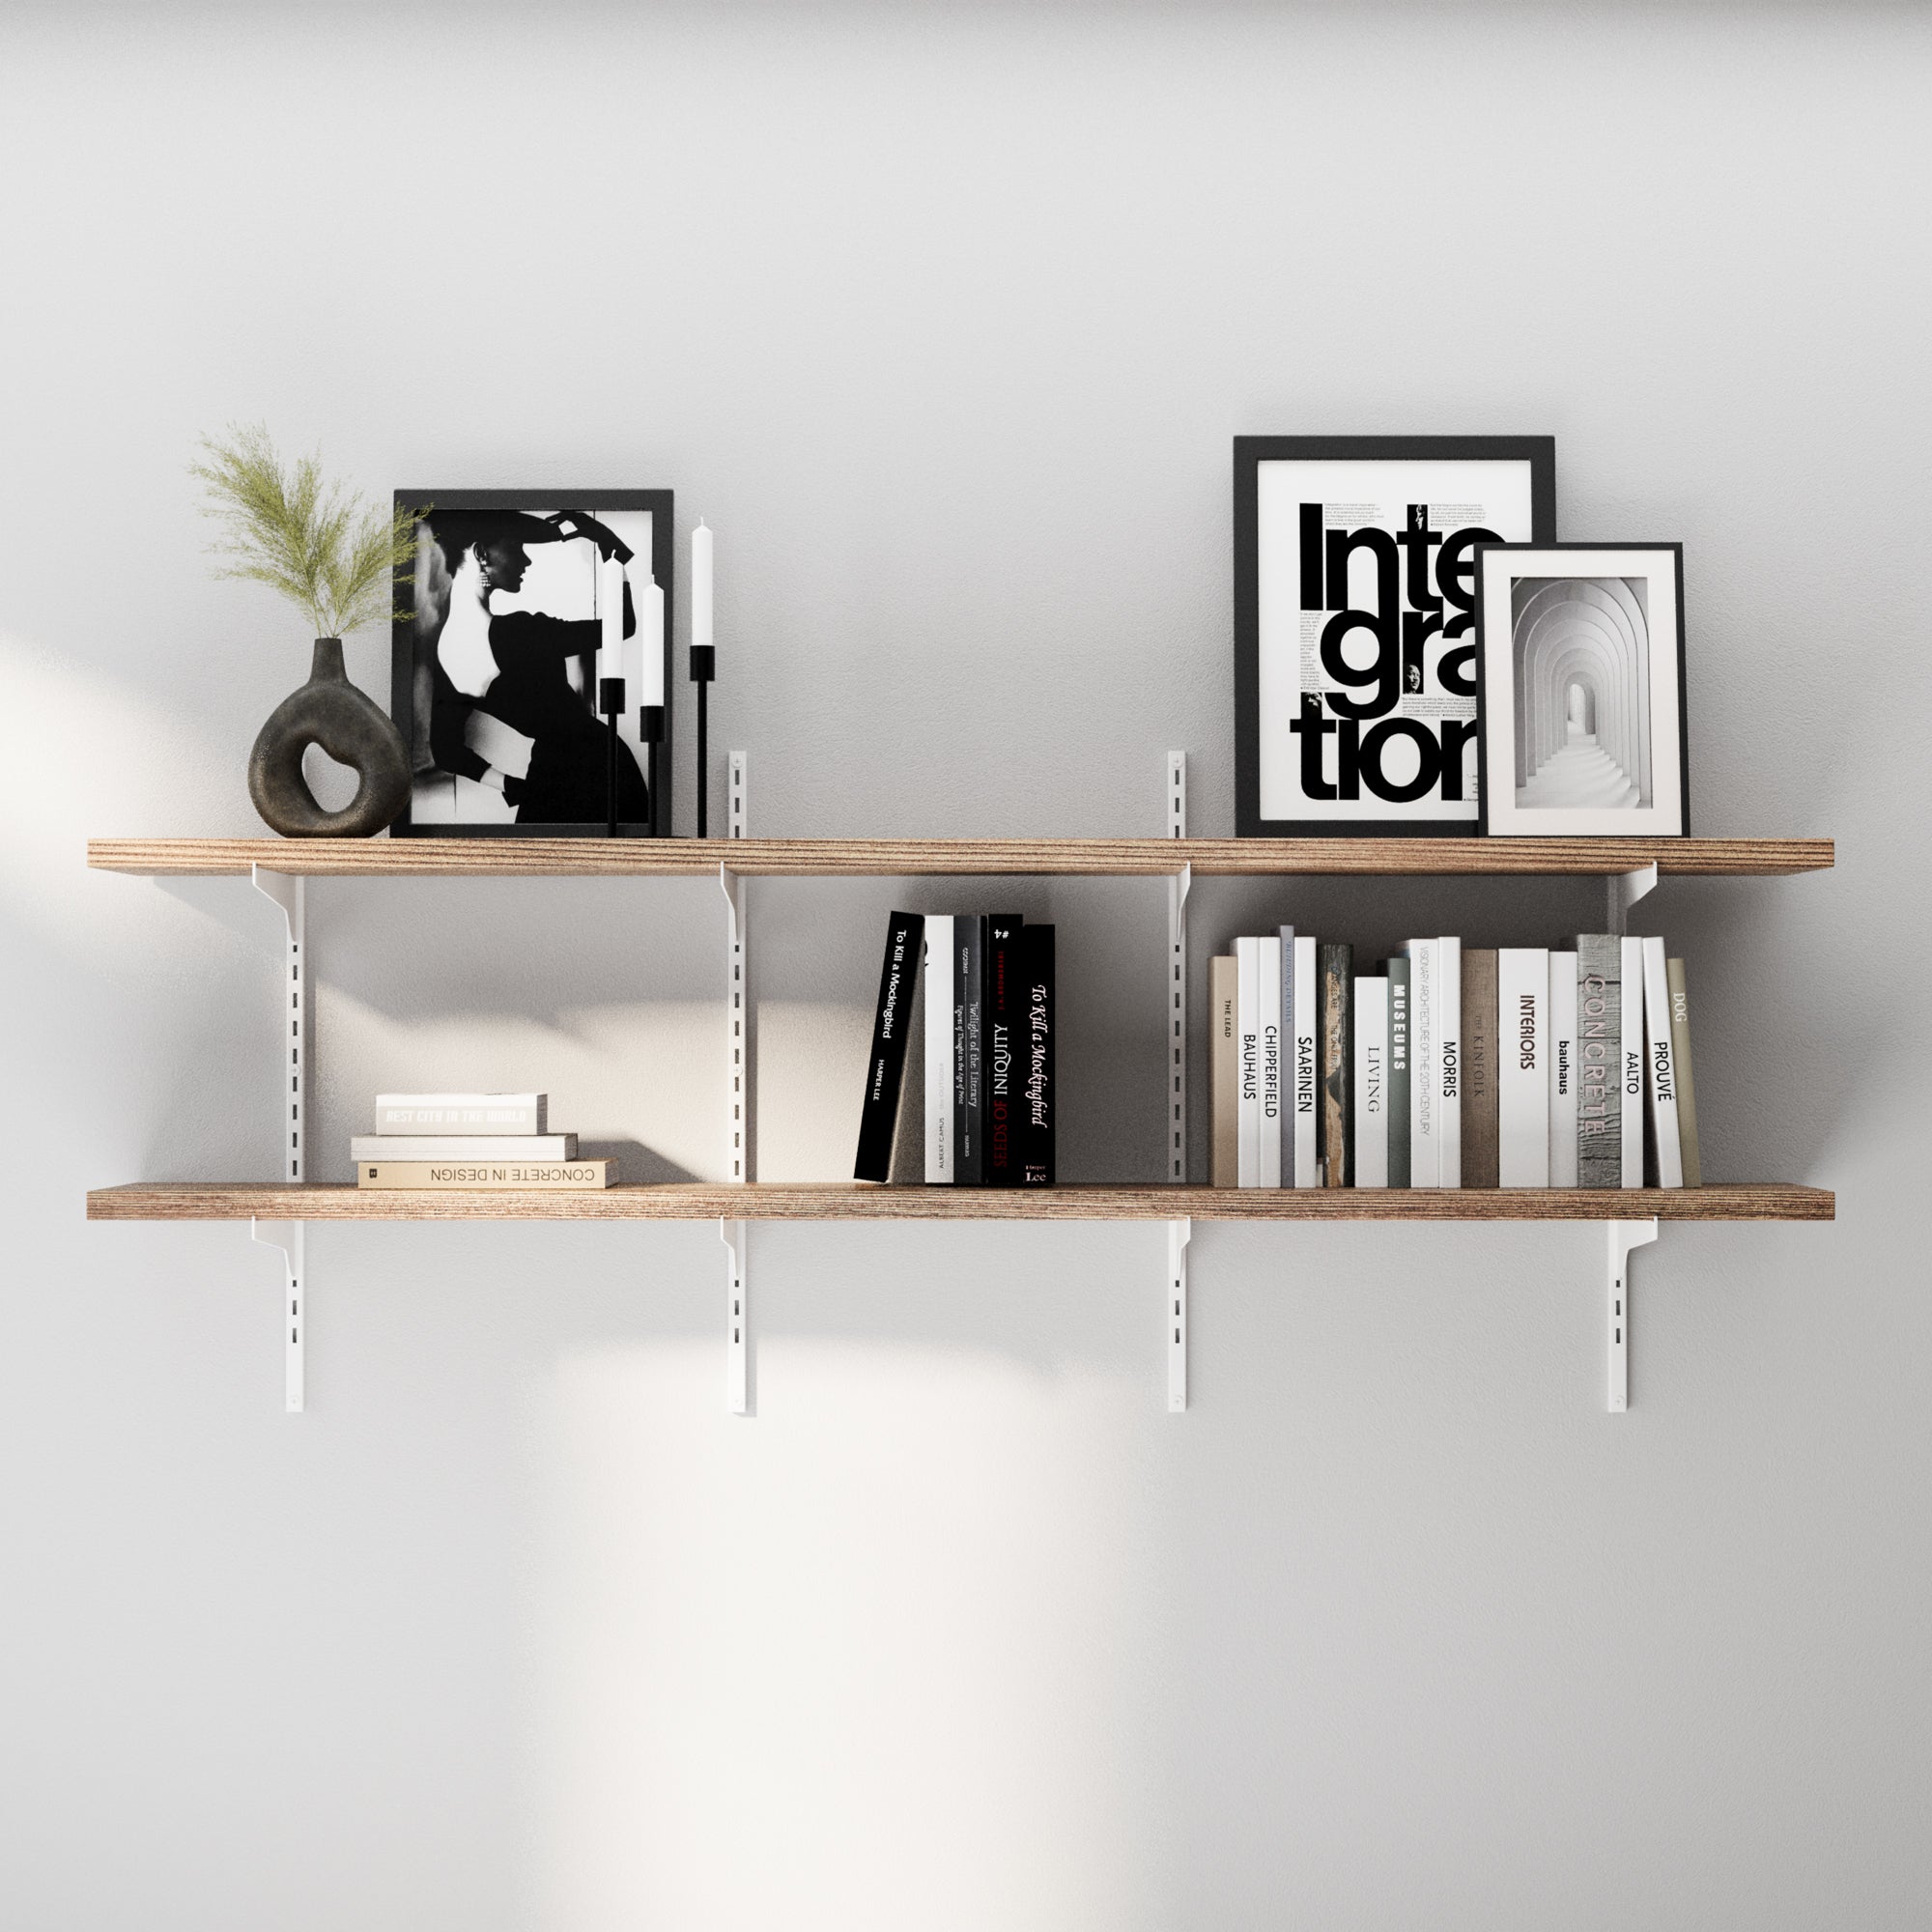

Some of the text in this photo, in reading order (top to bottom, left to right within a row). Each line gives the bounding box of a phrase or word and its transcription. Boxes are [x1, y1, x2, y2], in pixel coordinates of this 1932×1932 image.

[894, 945, 905, 962] Kill
[895, 930, 907, 943] To
[994, 928, 1009, 939] #4
[882, 972, 901, 1039] Mockingbird
[1032, 984, 1047, 1002] To
[1032, 1005, 1048, 1033] Kill
[1673, 992, 1688, 1023] DOG
[968, 1001, 980, 1107] Twilight of the Literary
[1394, 984, 1406, 1070] MUSEUMS
[1420, 947, 1430, 1136] VISIONARY ARCHITECTURE OF THE 20TH CENTURY
[1520, 994, 1536, 1070] INTERIORS
[1584, 975, 1605, 1134] CONCRETE
[872, 1059, 885, 1101] HARPER LEE
[993, 1023, 1011, 1168] SEEDS OF INIQUITY
[1025, 1044, 1048, 1128] Mockingbird
[1243, 1034, 1257, 1100] BAUHAUS
[1264, 1025, 1277, 1118] CHIPPERFIELD
[1297, 1037, 1313, 1113] SAARINEN
[1368, 1047, 1380, 1113] LIVING
[1442, 1041, 1457, 1097] MORRIS
[1473, 1036, 1485, 1097] KINFOLK
[1558, 1040, 1571, 1095] bauhaus
[1627, 1052, 1639, 1094] AALTO
[1654, 1042, 1675, 1102] PROUVÉ
[385, 1110, 414, 1122] BEST
[486, 1109, 526, 1122] WORLD
[431, 1168, 595, 1181] CONCRETE IN DESIGN
[1025, 1172, 1047, 1181] Lee
